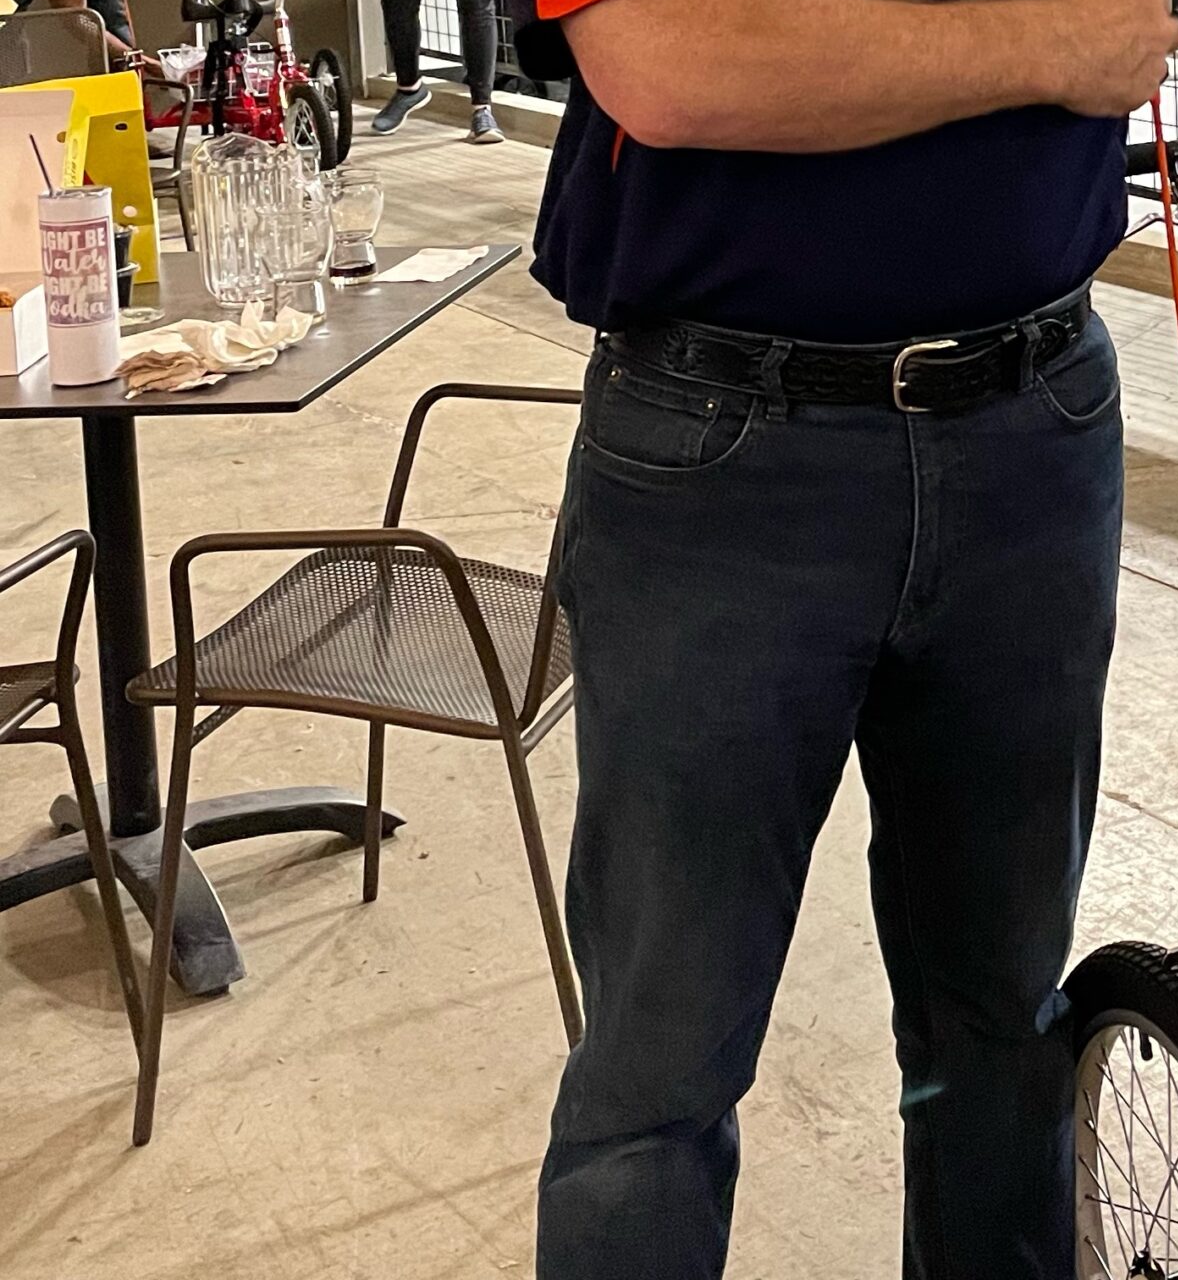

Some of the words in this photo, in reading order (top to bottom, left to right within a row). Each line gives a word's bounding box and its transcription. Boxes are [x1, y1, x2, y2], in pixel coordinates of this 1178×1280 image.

[42, 231, 81, 251] IGHT
[85, 227, 106, 249] BE
[87, 272, 108, 293] BE
[49, 285, 105, 320] odka
